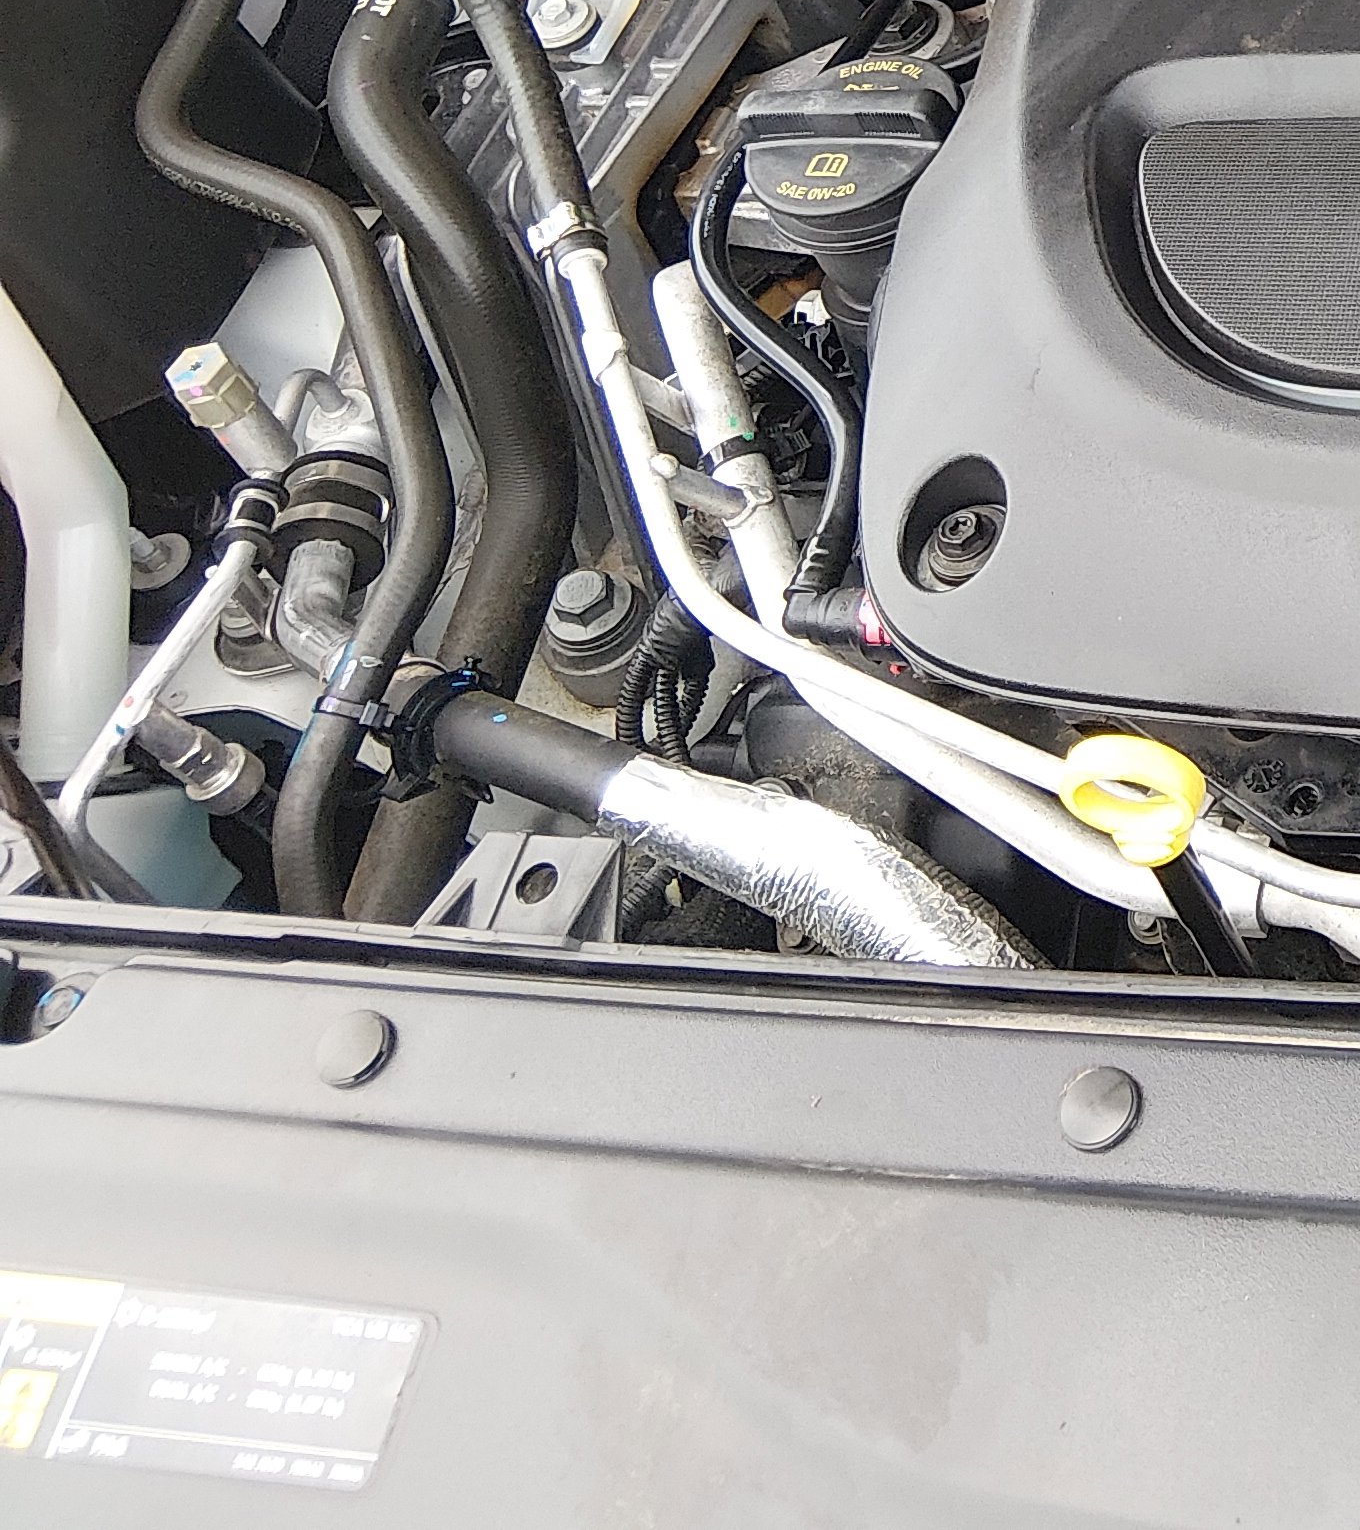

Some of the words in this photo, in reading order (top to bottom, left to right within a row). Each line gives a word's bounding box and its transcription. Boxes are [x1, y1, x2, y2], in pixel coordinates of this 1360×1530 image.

[839, 60, 903, 79] ENGINE
[901, 63, 925, 80] OIL
[776, 181, 809, 200] SAE
[807, 182, 857, 200] 0W-20
